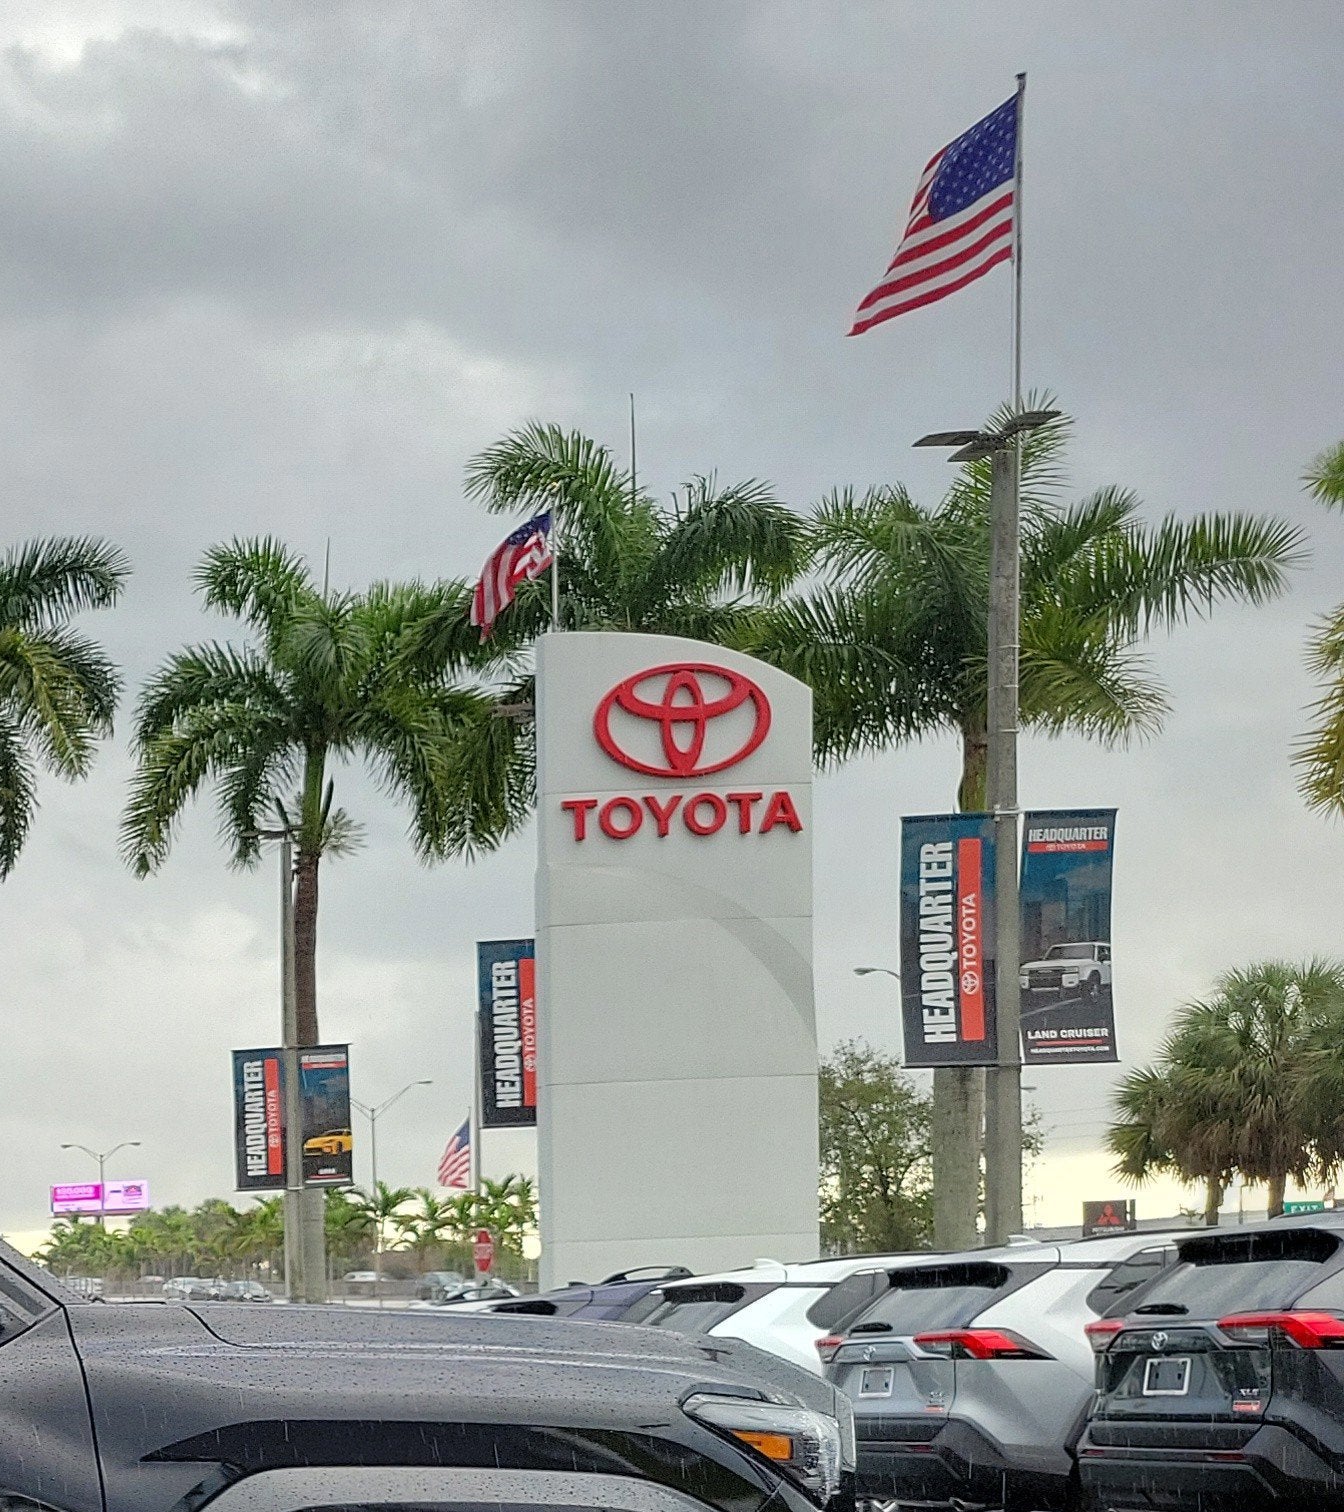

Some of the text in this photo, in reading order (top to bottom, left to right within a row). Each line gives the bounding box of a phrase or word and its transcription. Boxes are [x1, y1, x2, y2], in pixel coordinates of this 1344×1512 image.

[561, 791, 804, 842] TOYOTA
[1028, 826, 1109, 843] HEADQUARTER
[919, 841, 958, 1044] HEADQUARTER
[962, 893, 978, 969] TOYOTA
[492, 960, 522, 1108] HEADQUARTER
[522, 998, 536, 1050] TOYOTA
[1027, 1028, 1109, 1039] LAND CRUISER
[243, 1061, 268, 1176] HEADQUARTER
[267, 1090, 281, 1135] TOYOTA
[1291, 1204, 1318, 1213] EXIT
